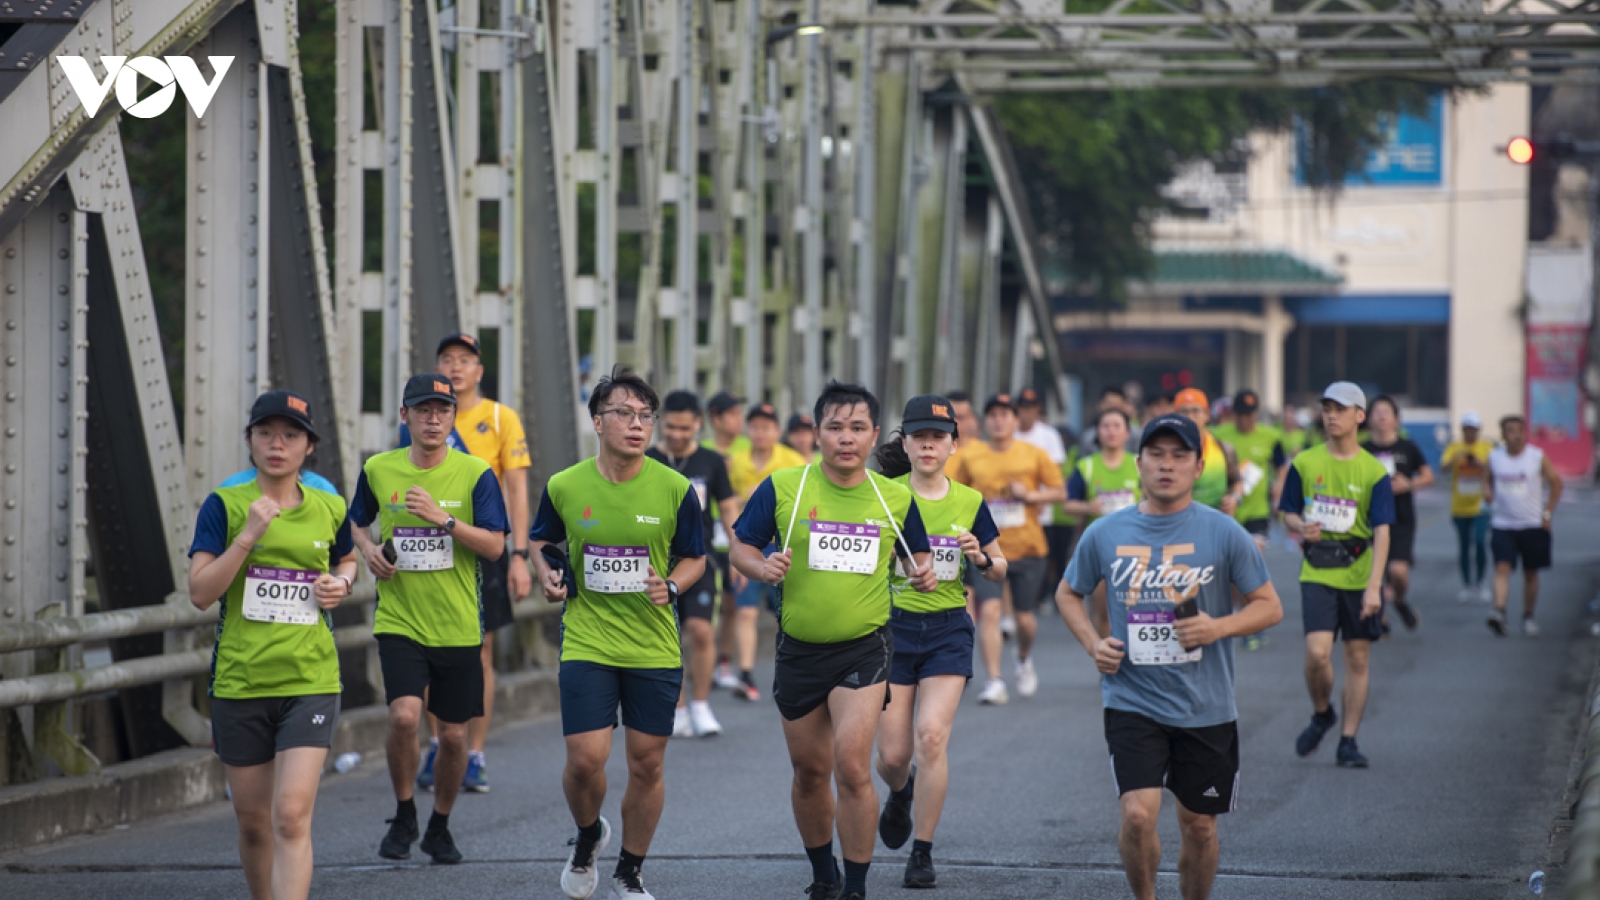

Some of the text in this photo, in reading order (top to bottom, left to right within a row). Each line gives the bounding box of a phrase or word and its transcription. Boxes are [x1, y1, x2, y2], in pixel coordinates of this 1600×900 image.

[401, 538, 446, 552] 62054
[818, 535, 872, 553] 60057
[931, 549, 955, 562] 56
[592, 558, 640, 573] 65031
[1115, 543, 1199, 606] 75
[1110, 557, 1215, 598] Vintage
[256, 582, 310, 601] 60170
